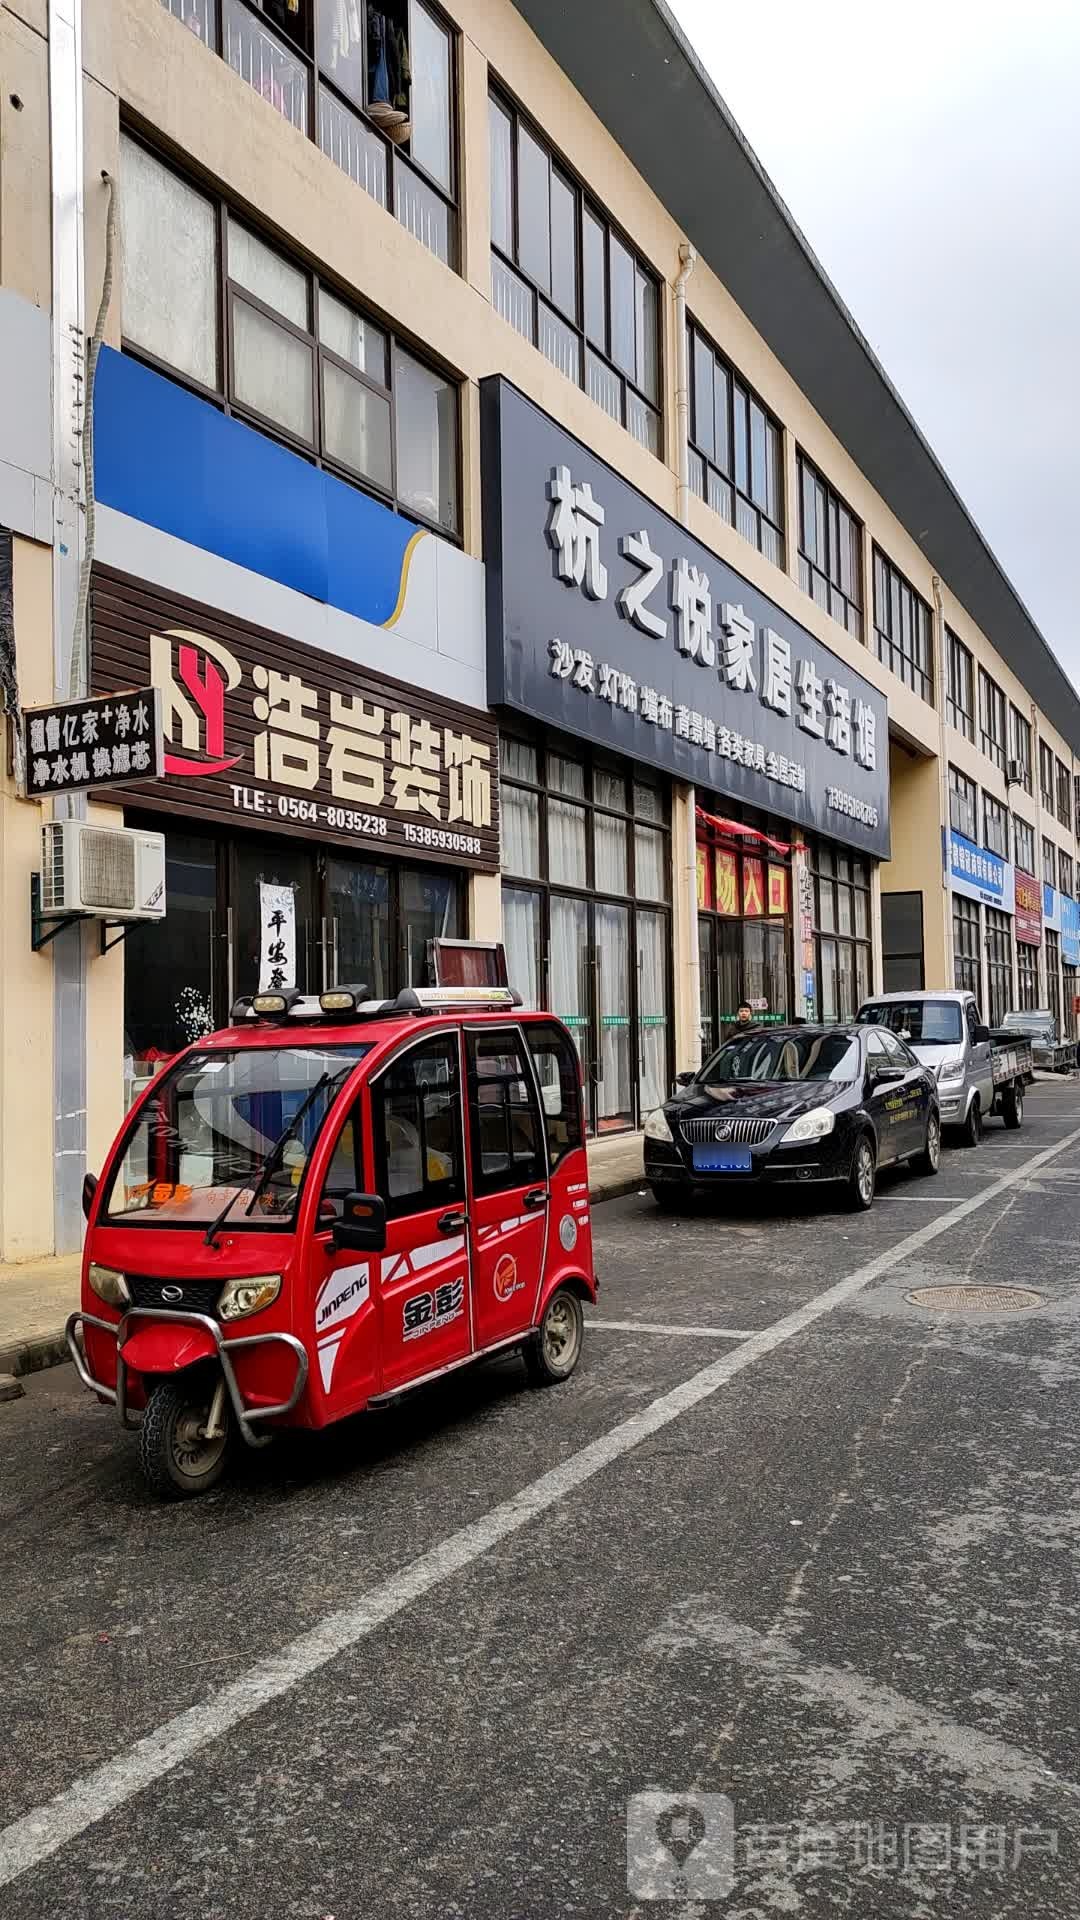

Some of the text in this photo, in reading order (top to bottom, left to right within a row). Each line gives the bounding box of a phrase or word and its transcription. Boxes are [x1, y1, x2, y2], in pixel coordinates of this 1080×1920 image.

[546, 464, 876, 771] 杭之悦家居生活馆
[548, 638, 595, 693] 沙发
[597, 663, 638, 712] 灯饰
[253, 665, 491, 827] 浩岩装饰
[230, 785, 482, 855] TLE: 0564-8035238 15385930588
[403, 1277, 463, 1331] 金彭
